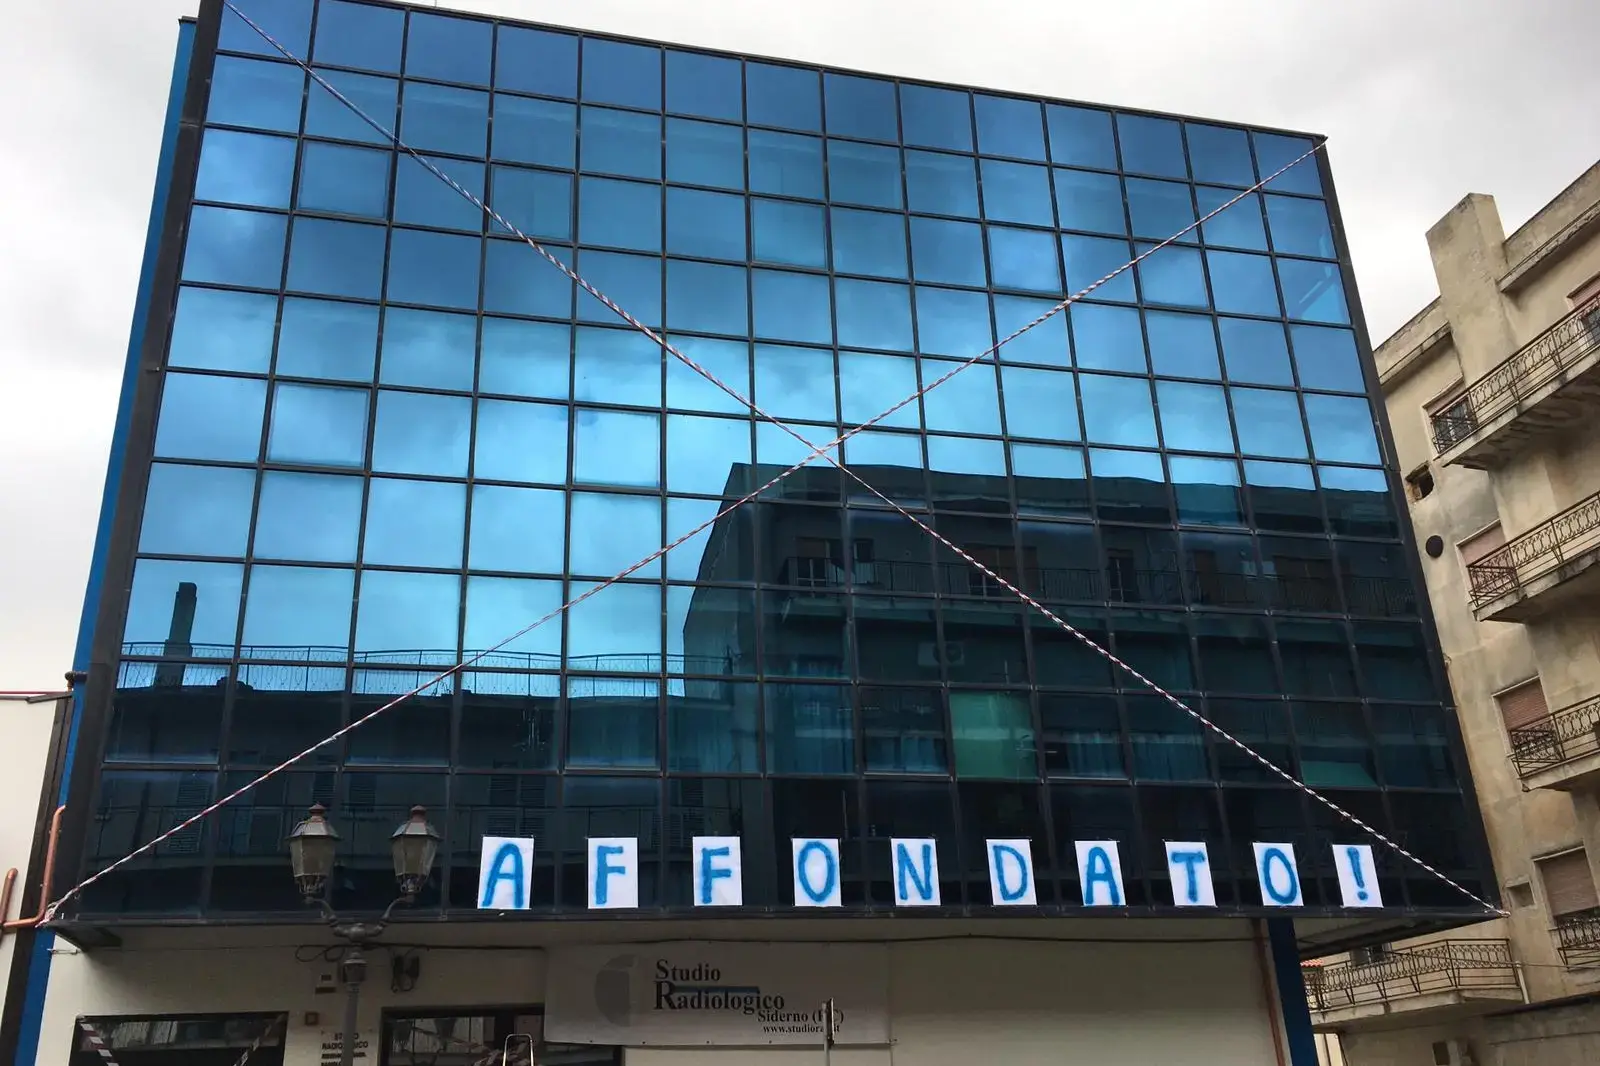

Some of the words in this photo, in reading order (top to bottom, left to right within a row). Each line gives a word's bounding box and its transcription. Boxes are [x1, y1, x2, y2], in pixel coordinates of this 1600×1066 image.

[655, 959, 721, 981] Studio
[653, 980, 785, 1015] Radiologico
[757, 1009, 808, 1022] Siderno
